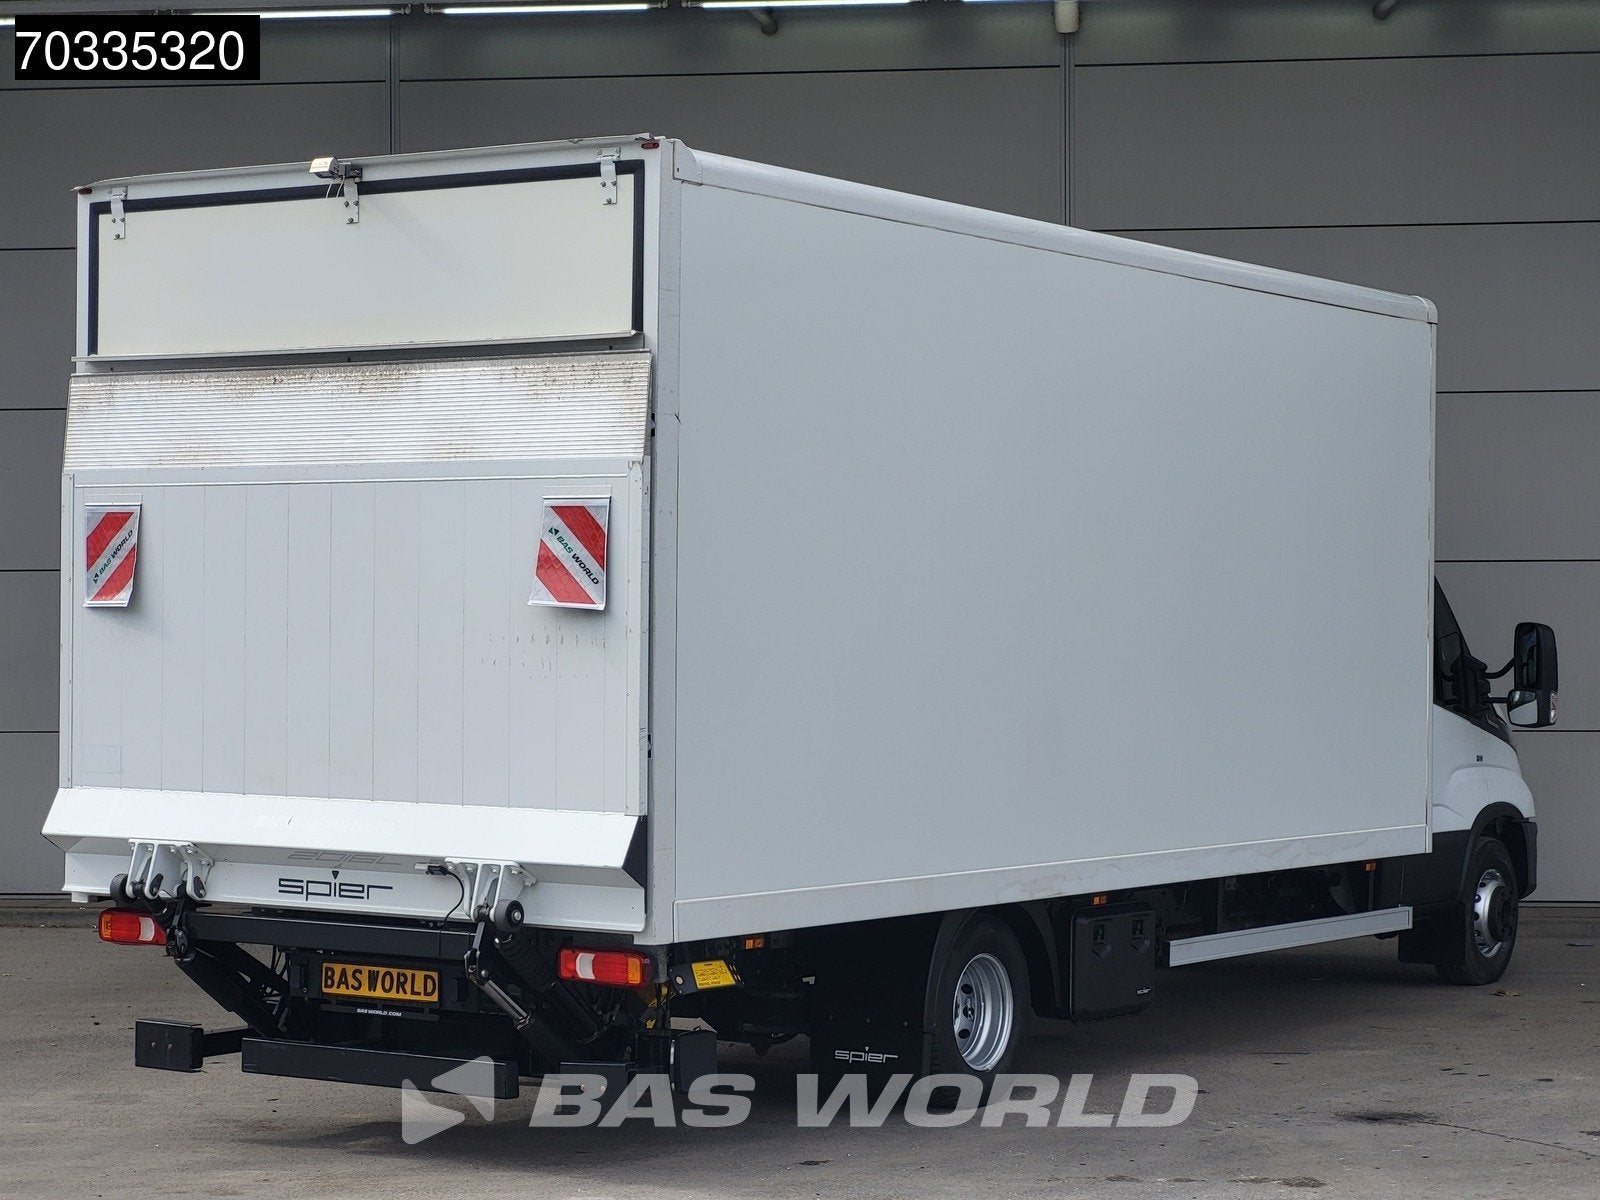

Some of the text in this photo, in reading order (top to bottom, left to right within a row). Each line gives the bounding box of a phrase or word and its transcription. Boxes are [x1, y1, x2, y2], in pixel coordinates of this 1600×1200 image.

[98, 529, 134, 576] BAS WORLD
[556, 535, 600, 585] BAS WORLD
[278, 870, 394, 902] spier
[323, 966, 437, 997] BAS WORLD
[834, 1046, 899, 1064] spier
